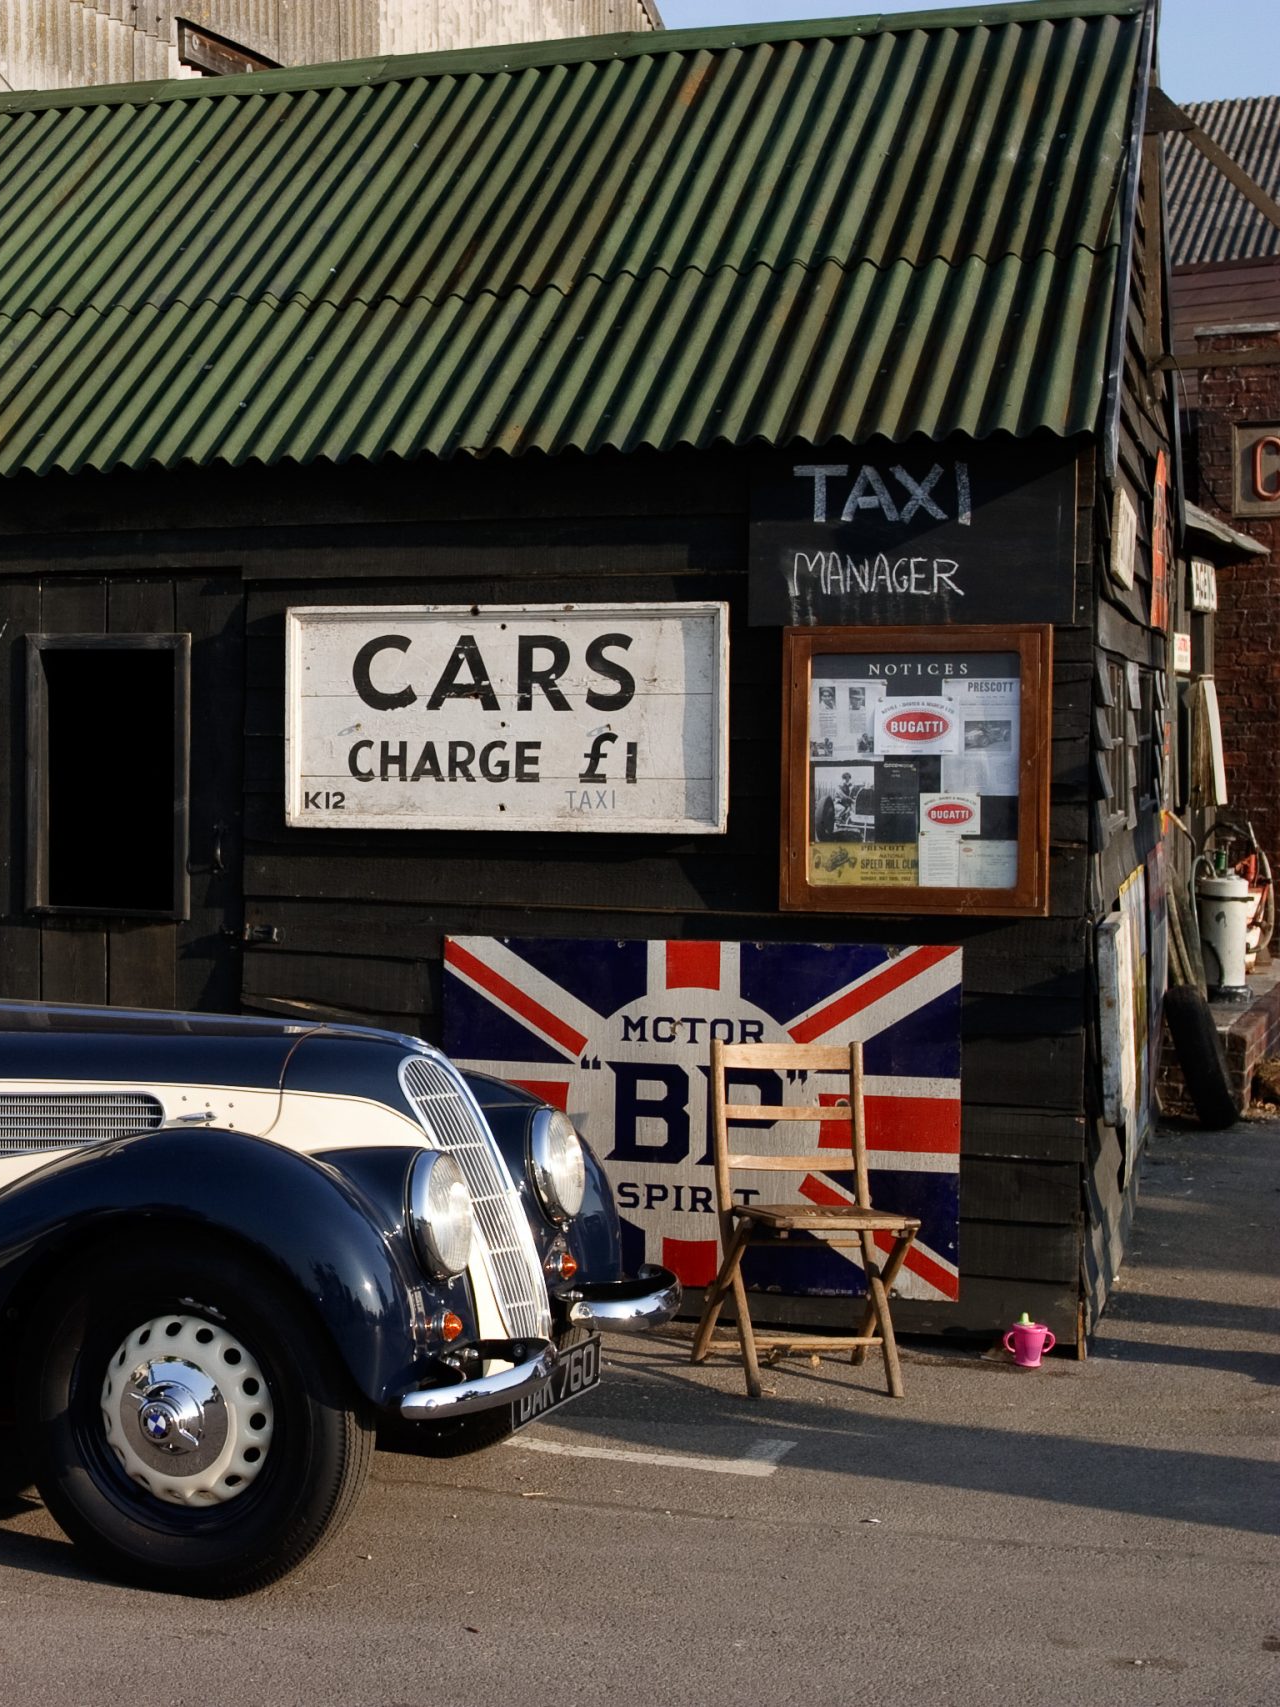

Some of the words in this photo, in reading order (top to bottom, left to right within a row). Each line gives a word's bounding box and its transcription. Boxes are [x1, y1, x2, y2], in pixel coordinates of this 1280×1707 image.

[793, 461, 971, 526] TAXI
[790, 551, 965, 596] MANAGER
[352, 632, 636, 712] CARS
[869, 663, 969, 676] NOTICES
[967, 681, 1014, 692] PRESCOTT
[890, 721, 943, 733] BUGATTI
[348, 739, 542, 783] CHARGE
[565, 790, 617, 809] TAXI
[931, 810, 969, 819] BUGATTI
[621, 1015, 764, 1045] MOTOR
[618, 1182, 760, 1213] SPIRT
[560, 1343, 595, 1399] 760
